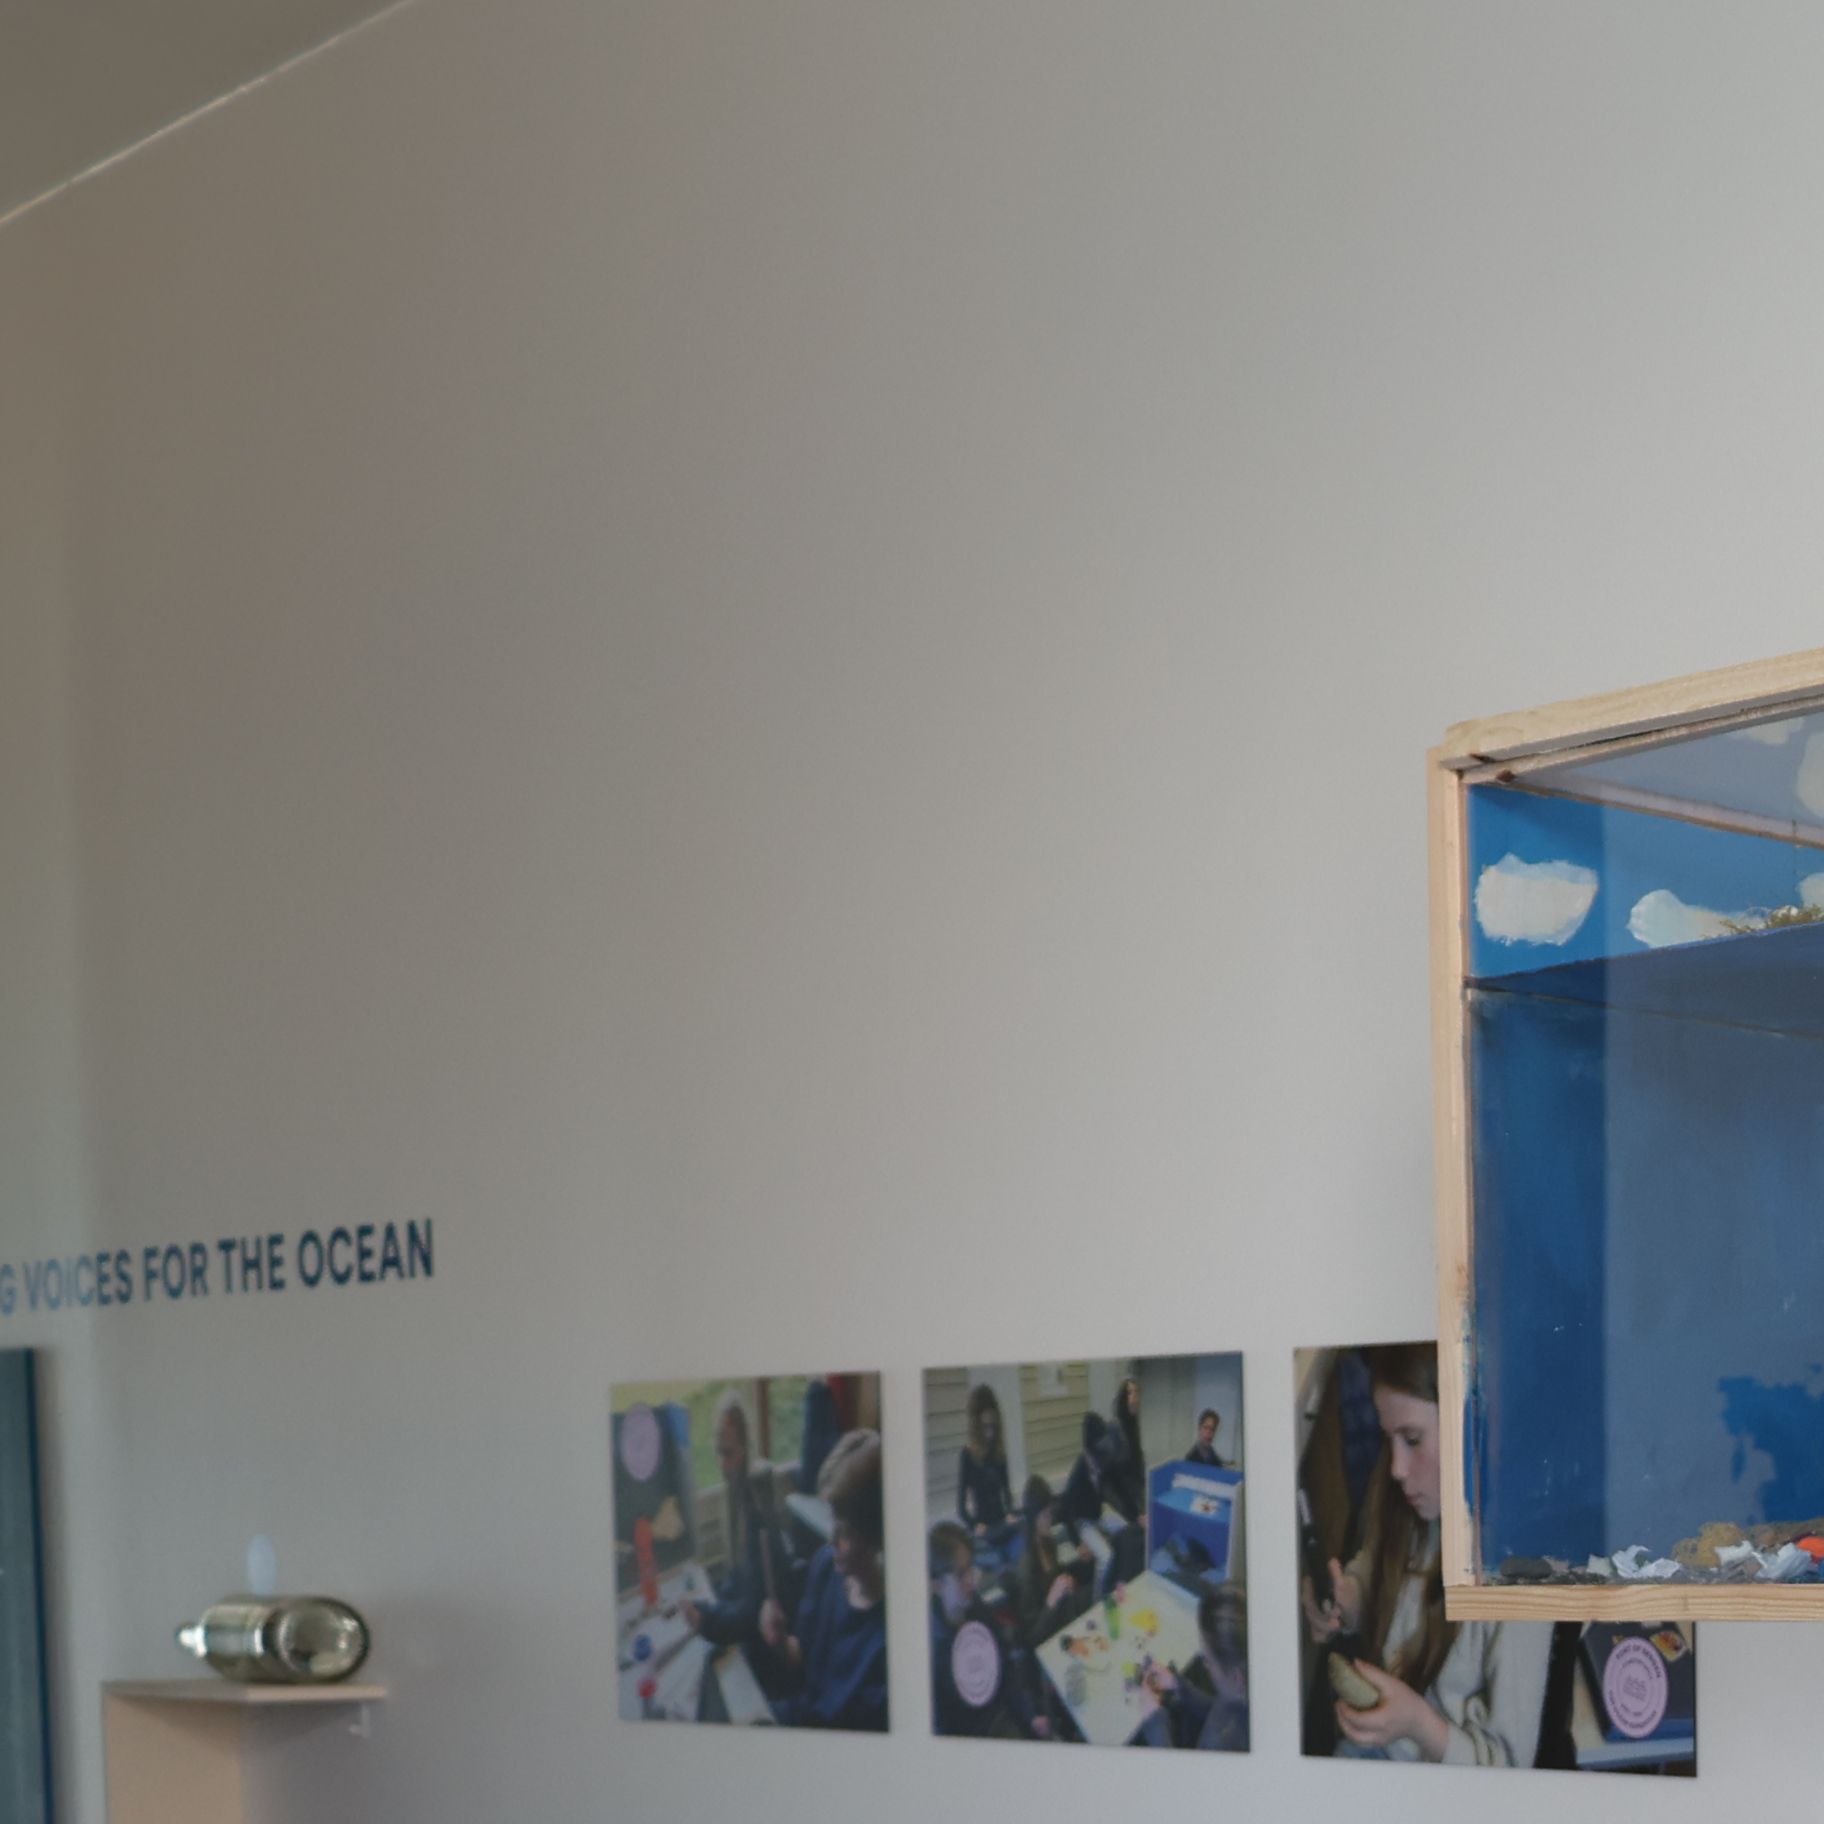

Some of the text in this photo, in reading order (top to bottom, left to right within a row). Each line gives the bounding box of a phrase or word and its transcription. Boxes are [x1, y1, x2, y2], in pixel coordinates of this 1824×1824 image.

[22, 1246, 134, 1311] VOICES
[142, 1240, 209, 1302] FOR
[217, 1232, 286, 1294] THE
[298, 1217, 434, 1289] OCEAN
